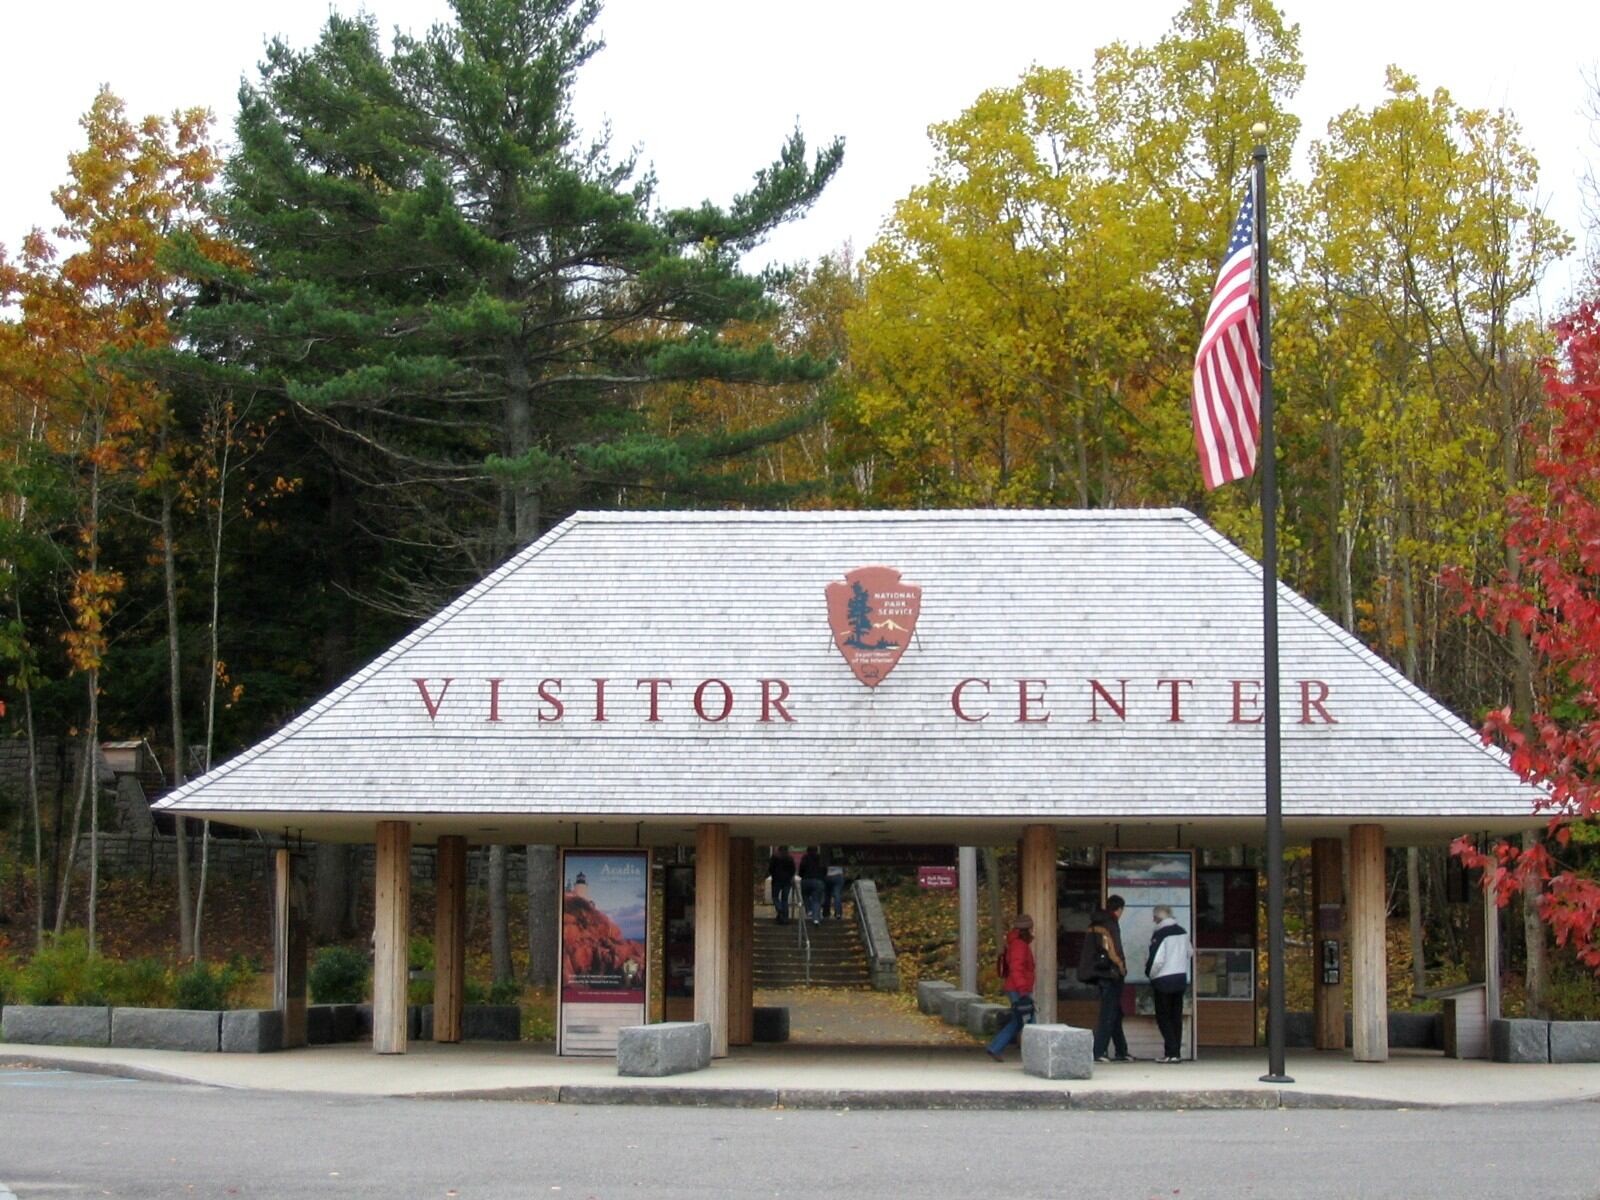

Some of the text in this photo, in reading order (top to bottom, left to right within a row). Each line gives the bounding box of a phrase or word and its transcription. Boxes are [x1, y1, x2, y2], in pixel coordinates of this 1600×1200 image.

[412, 678, 1339, 724] VISITOR CENTER
[600, 864, 641, 875] Acadia
